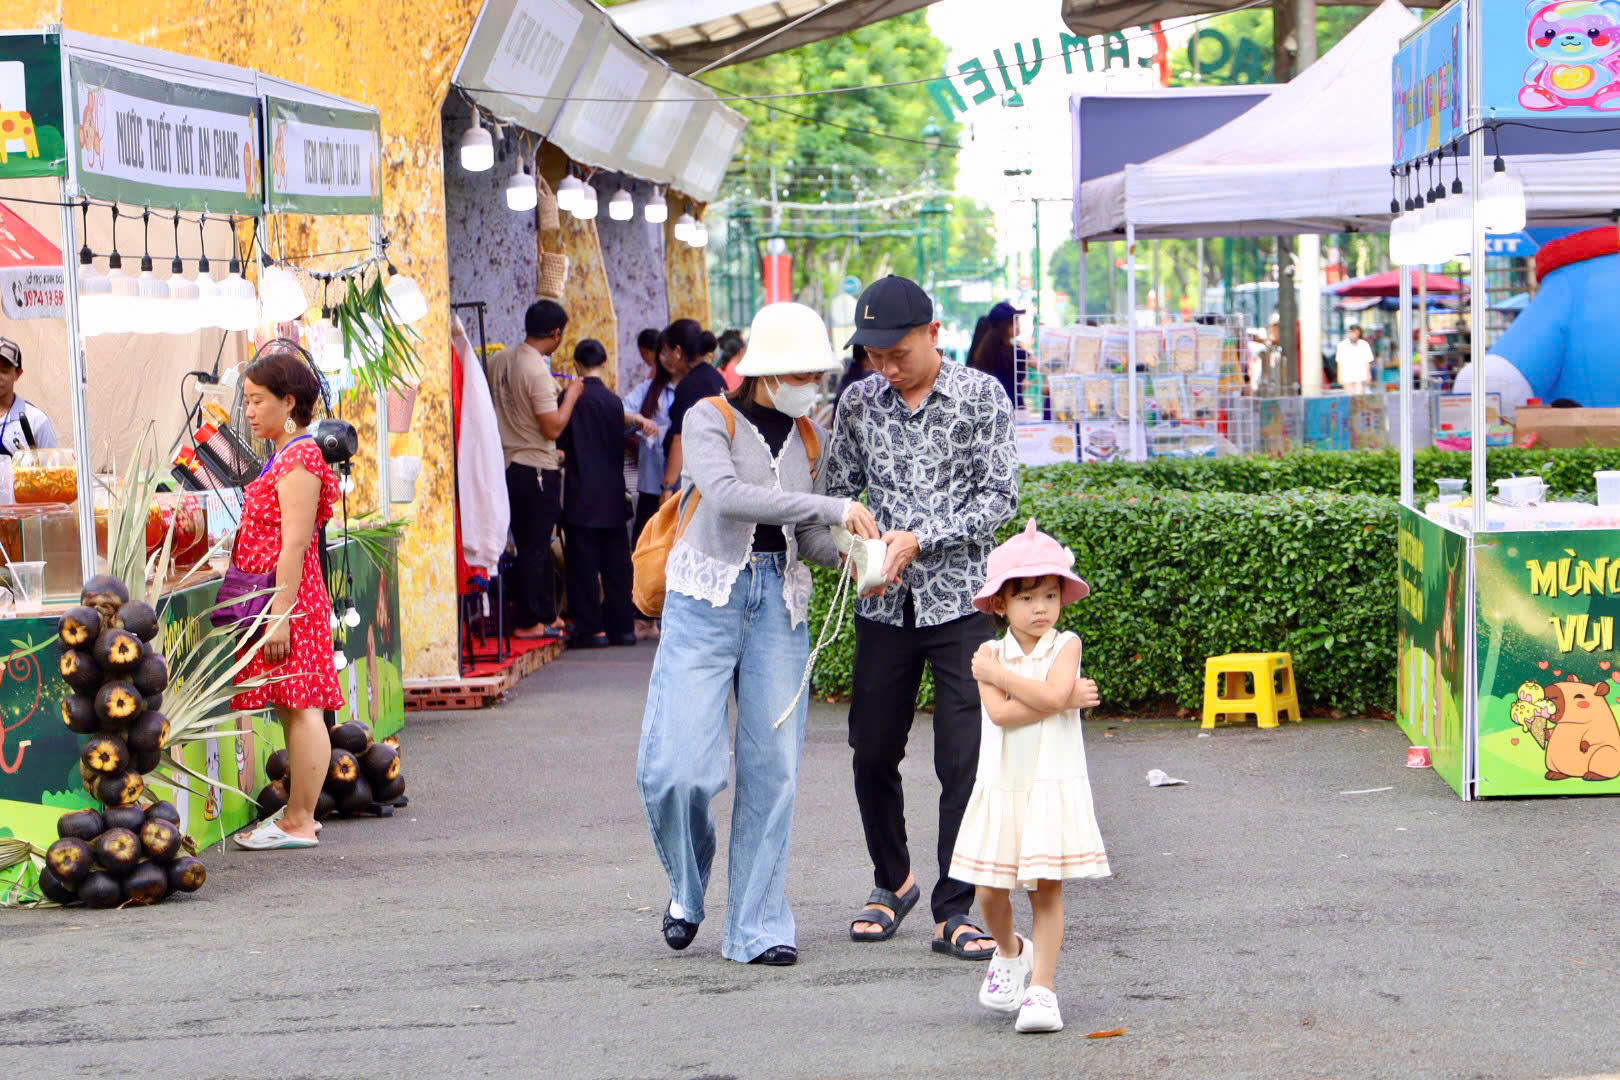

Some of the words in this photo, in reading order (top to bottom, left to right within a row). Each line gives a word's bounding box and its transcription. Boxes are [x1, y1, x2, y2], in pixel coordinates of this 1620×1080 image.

[116, 107, 145, 170] NƯỚC
[146, 111, 173, 175] THỐT
[175, 114, 195, 176] NỐT
[199, 126, 212, 177] AN
[213, 128, 240, 180] GIANG
[863, 304, 875, 320] L
[1549, 614, 1614, 654] VUI
